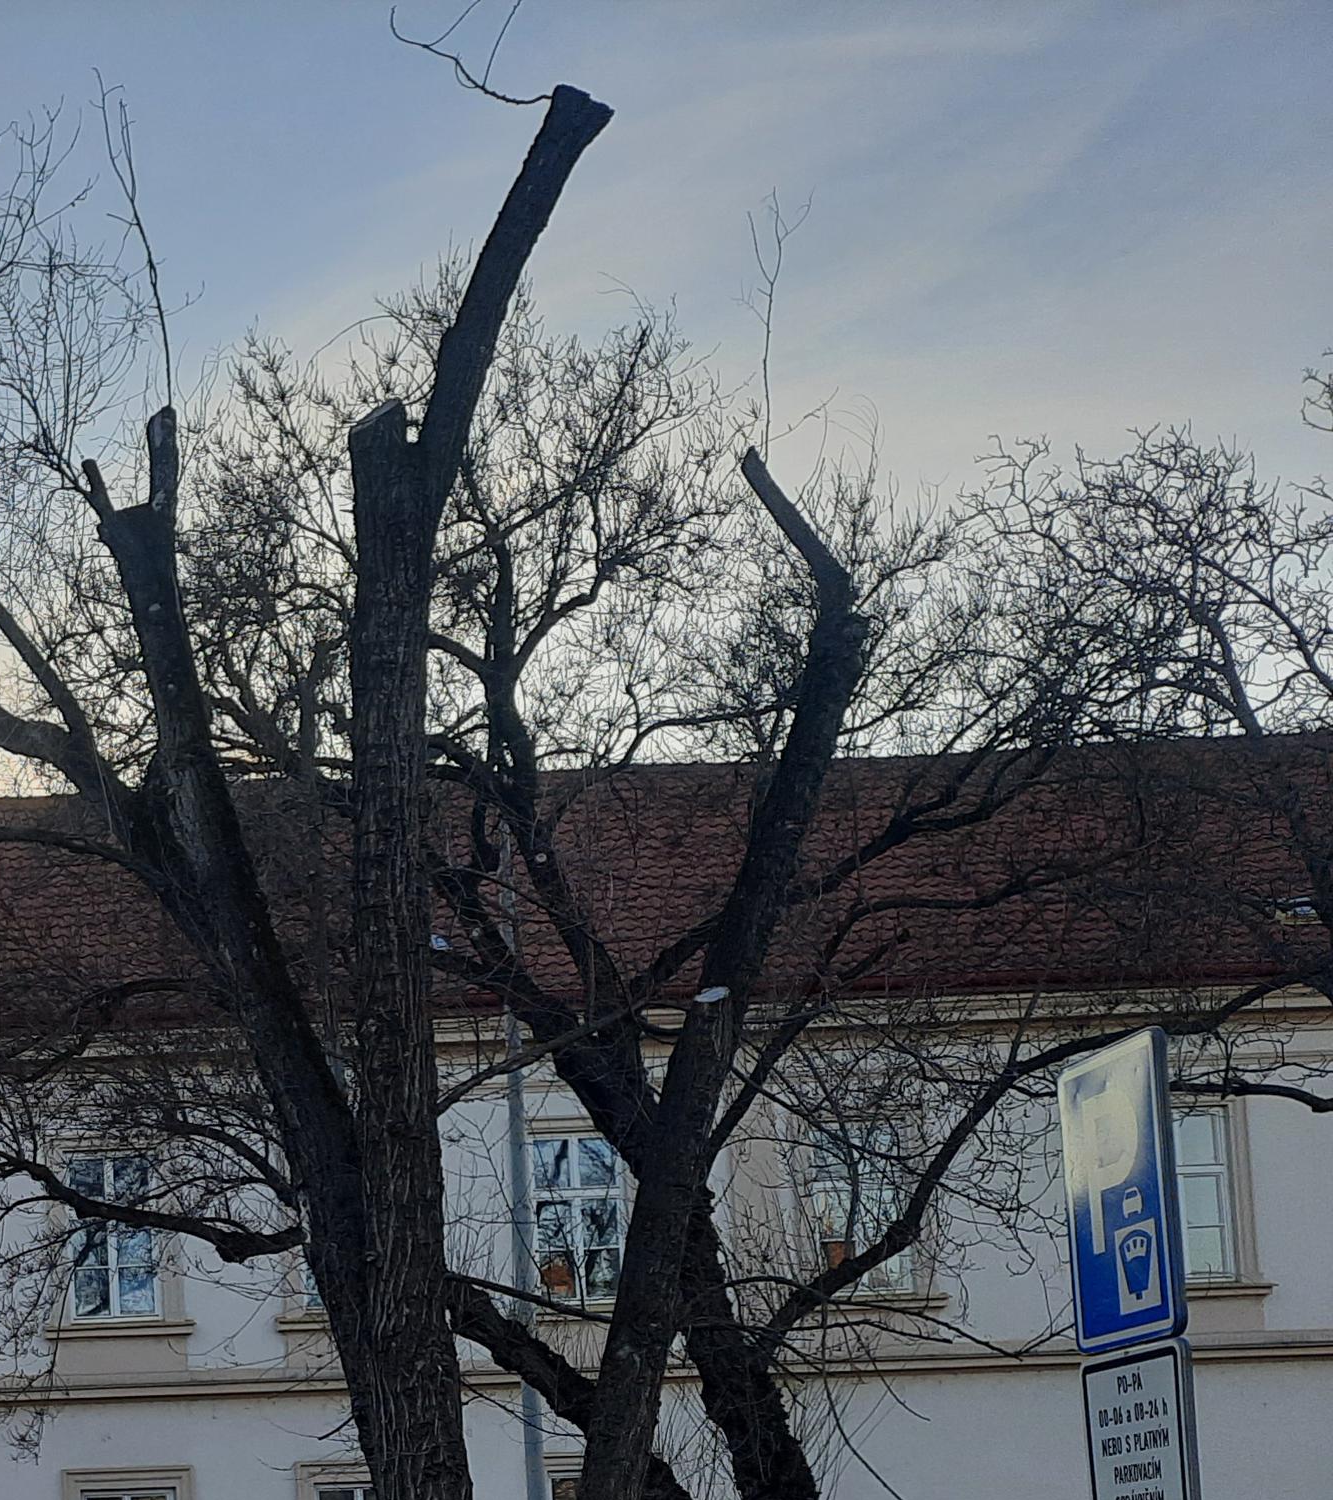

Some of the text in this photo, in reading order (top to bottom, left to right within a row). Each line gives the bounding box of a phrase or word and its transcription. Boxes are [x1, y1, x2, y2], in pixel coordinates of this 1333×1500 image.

[1117, 1366, 1143, 1395] PO-PÁ
[1098, 1397, 1168, 1429] 00-06 a 08-24 h
[1101, 1423, 1170, 1457] NEBO S PLATNÝM
[1114, 1456, 1162, 1485] PARKOVACÍM
